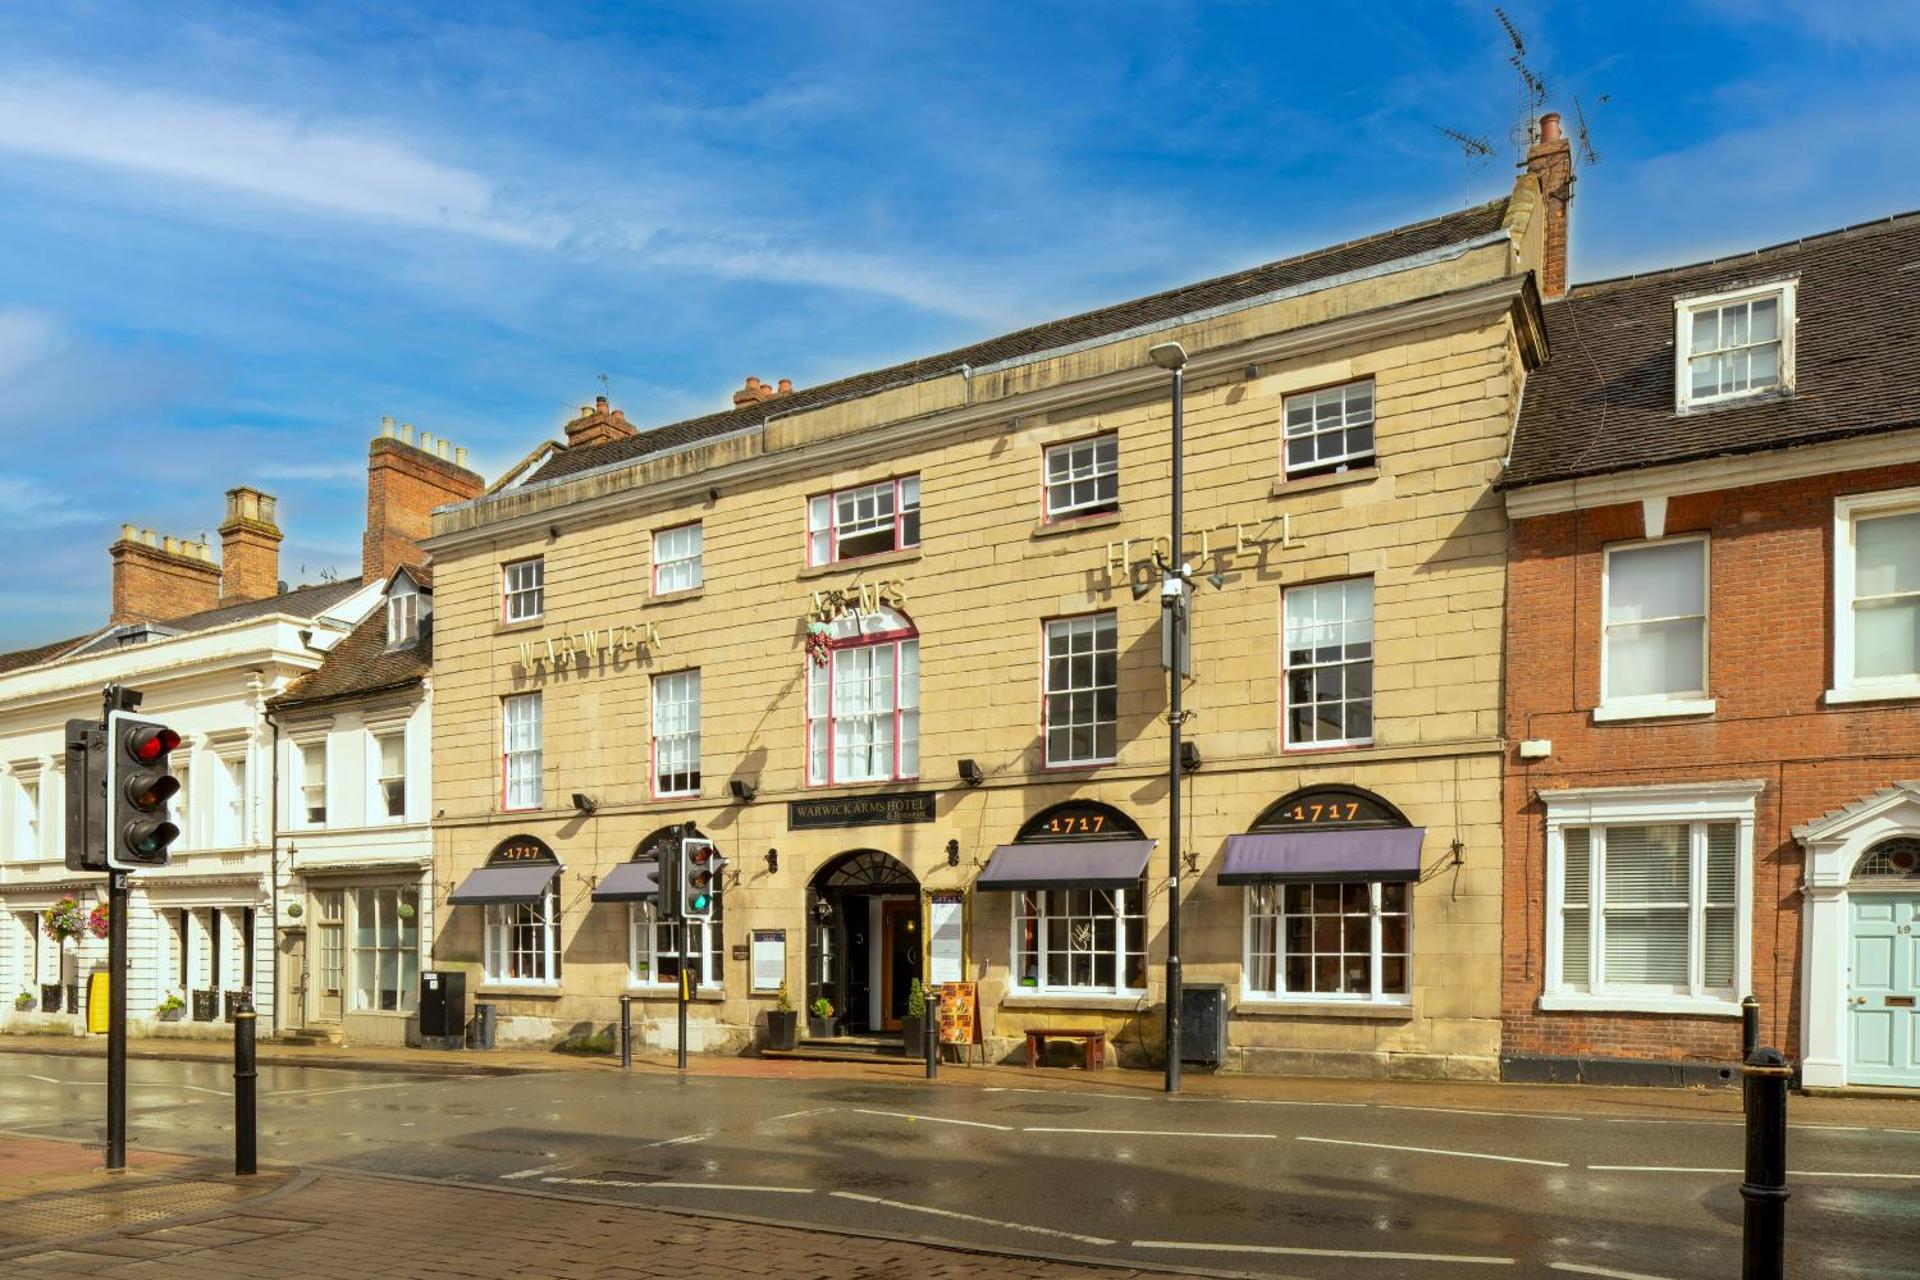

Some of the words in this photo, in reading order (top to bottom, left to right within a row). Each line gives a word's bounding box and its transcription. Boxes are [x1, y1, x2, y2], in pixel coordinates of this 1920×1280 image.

[1106, 512, 1308, 577] HOTEL
[519, 620, 662, 669] WARWICK
[798, 804, 850, 817] WARWICK
[852, 801, 885, 814] ARMS
[887, 799, 926, 811] HOTEL
[1294, 803, 1359, 822] 1717
[1051, 816, 1104, 833] 1717
[508, 846, 539, 859] 1717
[1897, 925, 1911, 934] 19
